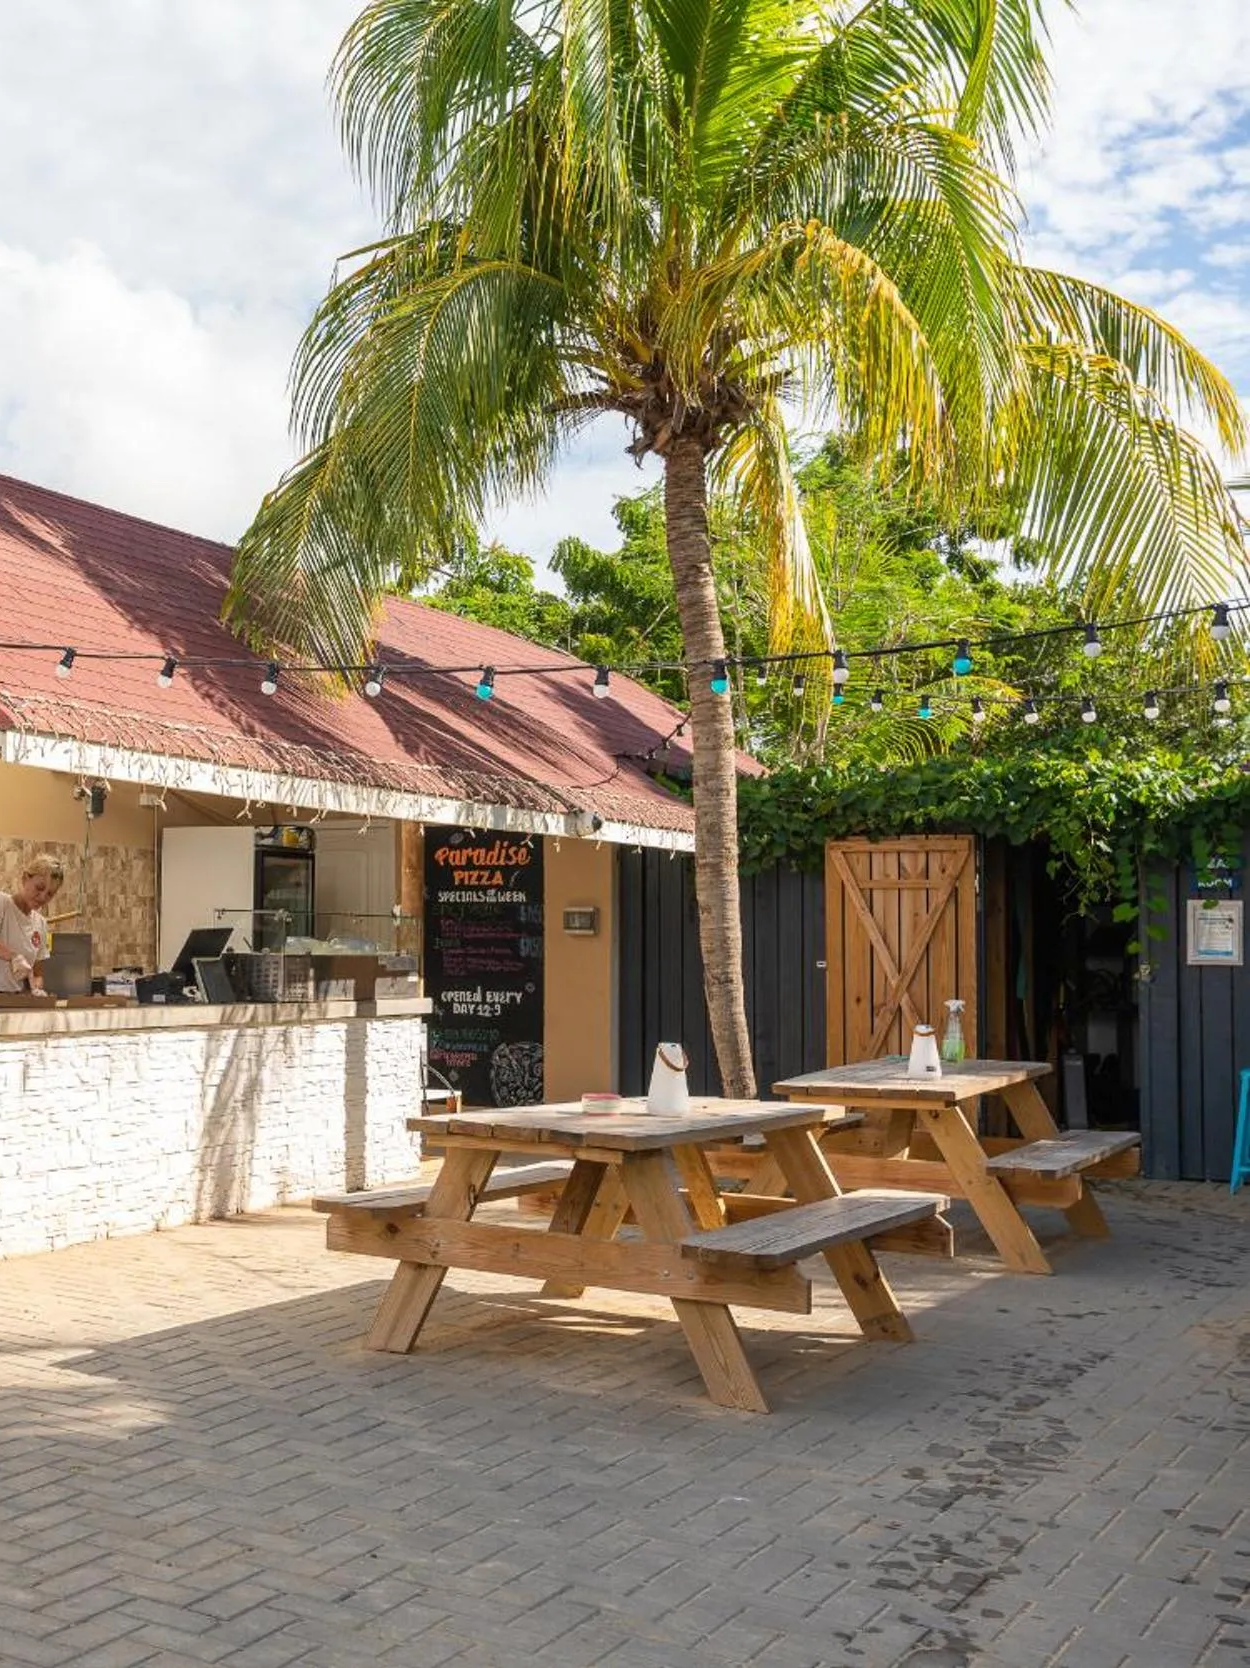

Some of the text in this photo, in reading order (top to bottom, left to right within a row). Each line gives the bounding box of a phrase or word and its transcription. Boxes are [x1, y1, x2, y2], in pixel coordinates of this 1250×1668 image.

[434, 840, 532, 867] Paradise
[453, 870, 504, 886] PIZZA
[452, 1003, 476, 1015] DAY
